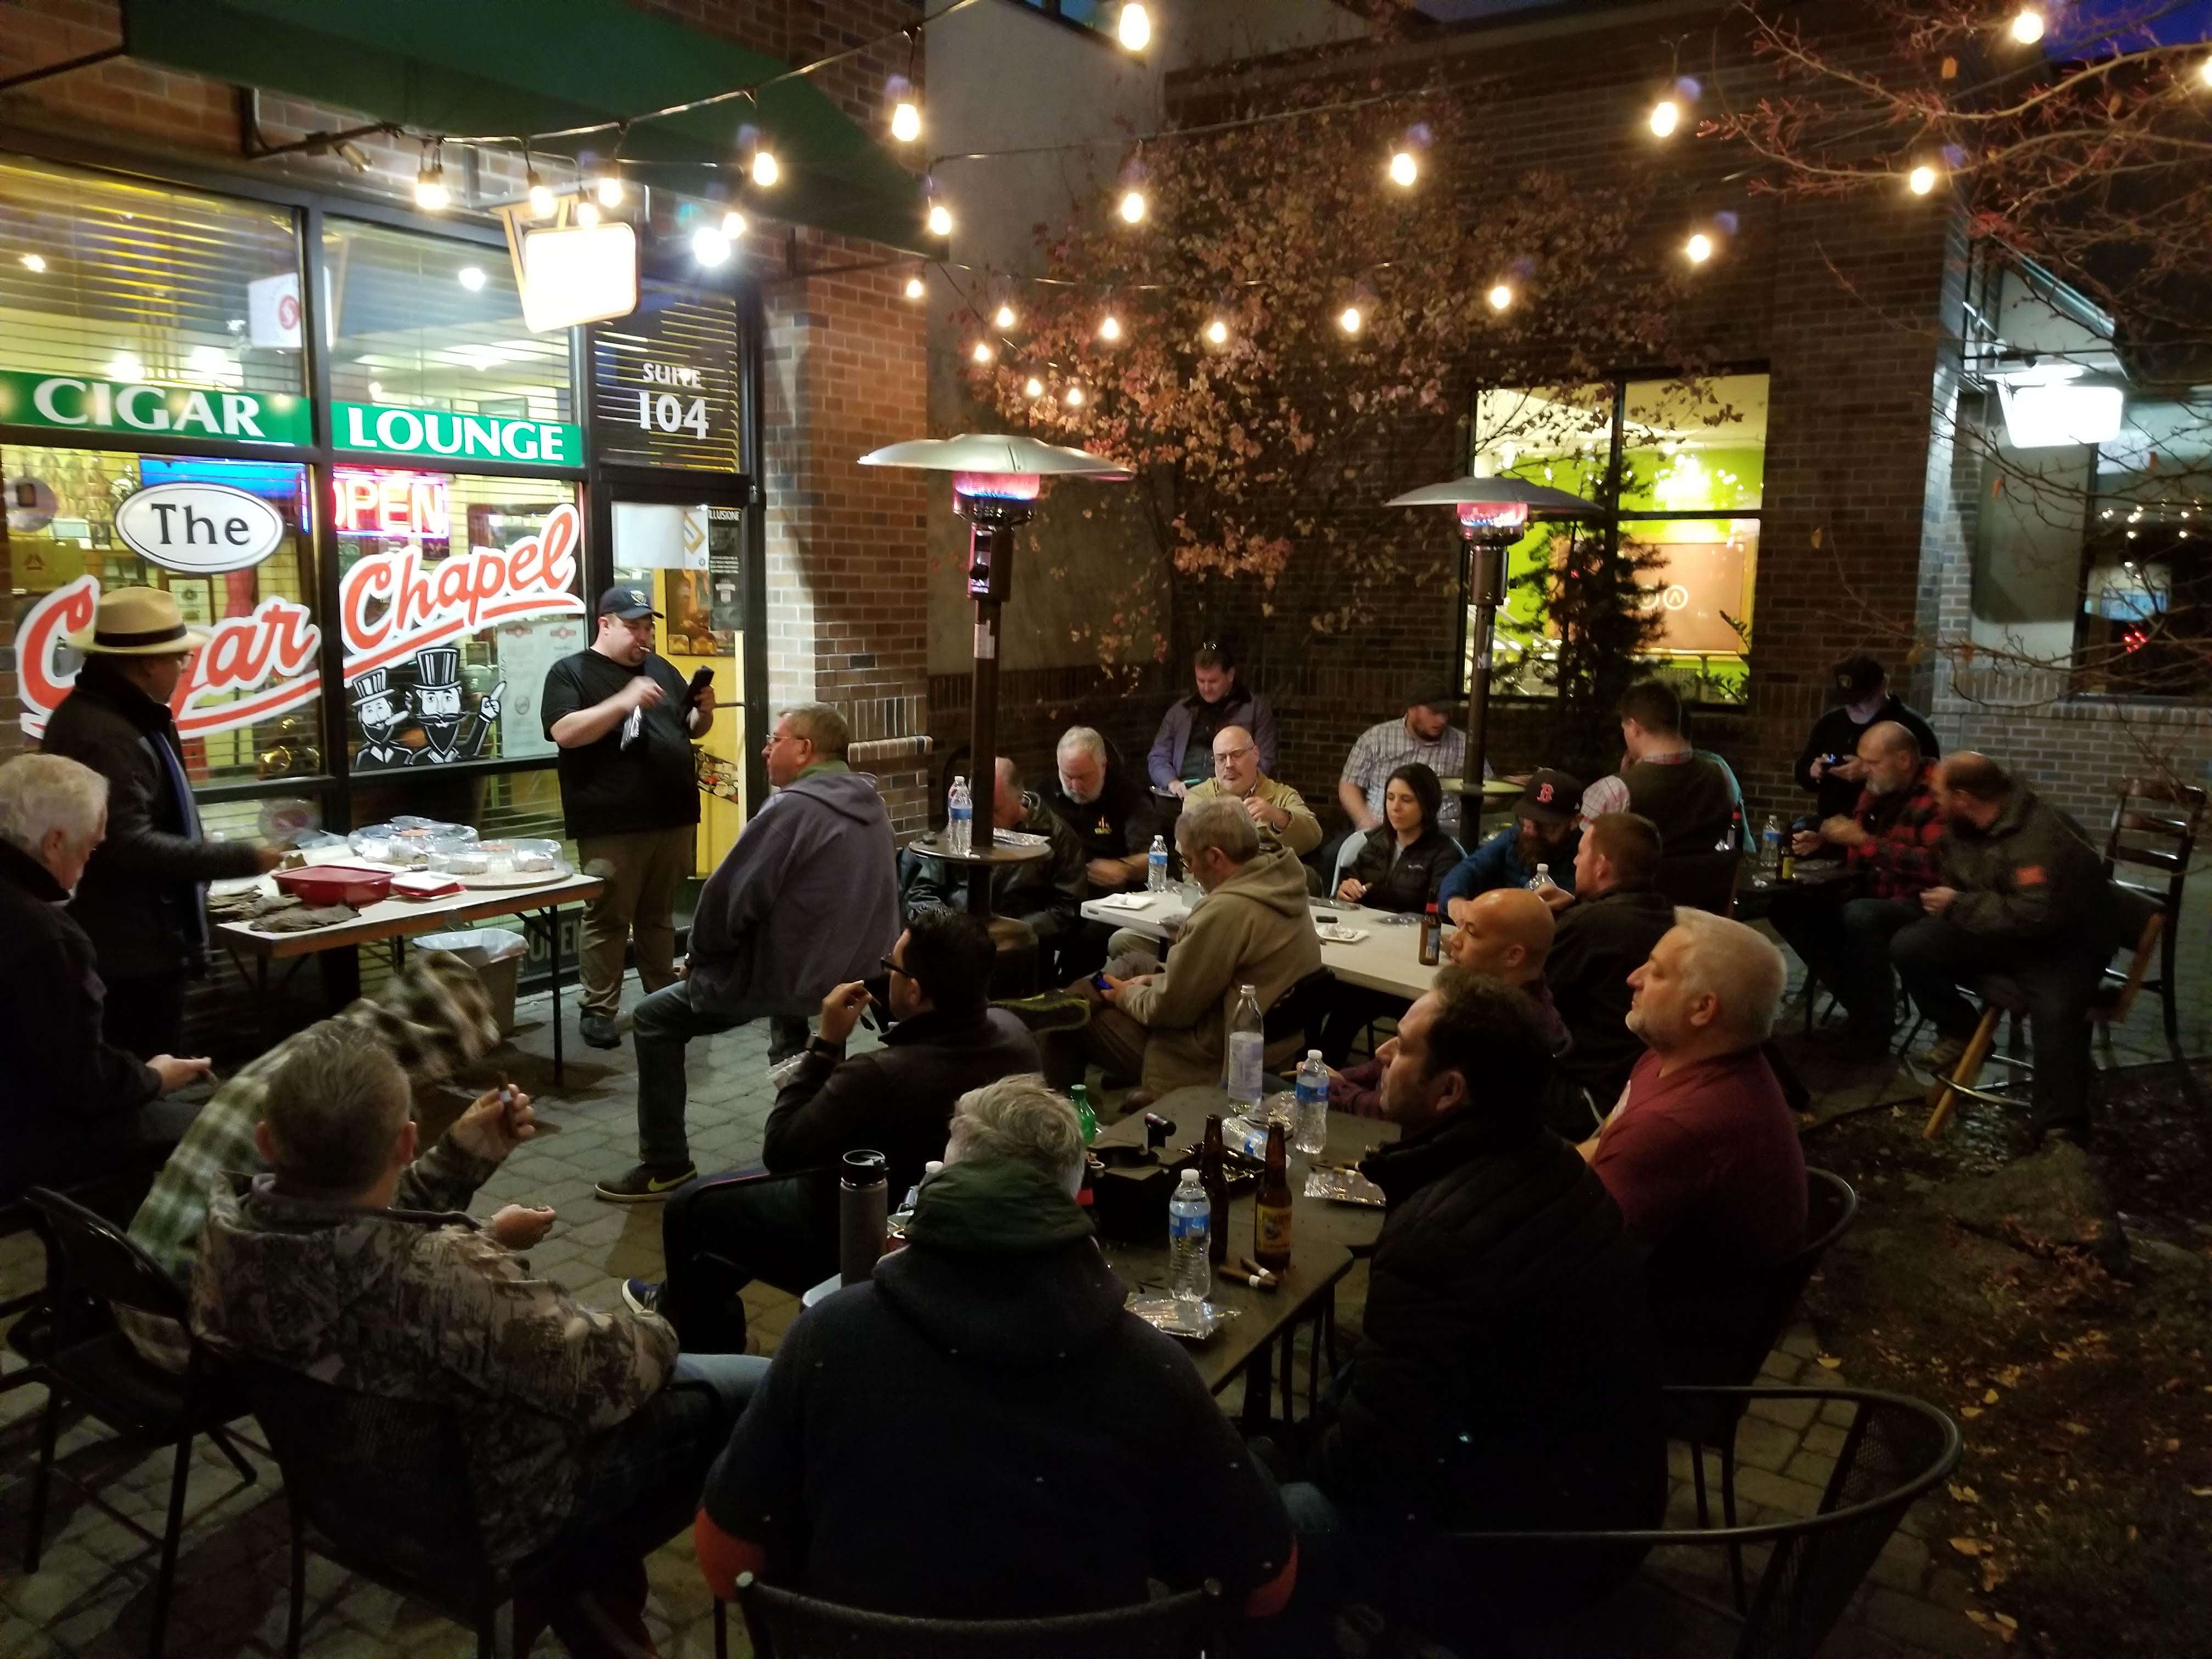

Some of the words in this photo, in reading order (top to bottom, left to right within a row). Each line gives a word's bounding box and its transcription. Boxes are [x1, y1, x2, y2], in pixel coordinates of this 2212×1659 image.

[643, 363, 704, 388] SUITE
[33, 378, 266, 437] CIGAR
[347, 406, 565, 462] LOUNGE
[639, 392, 709, 440] 104
[151, 503, 251, 546] The
[343, 508, 575, 648] Chapel
[1537, 783, 1554, 803] B
